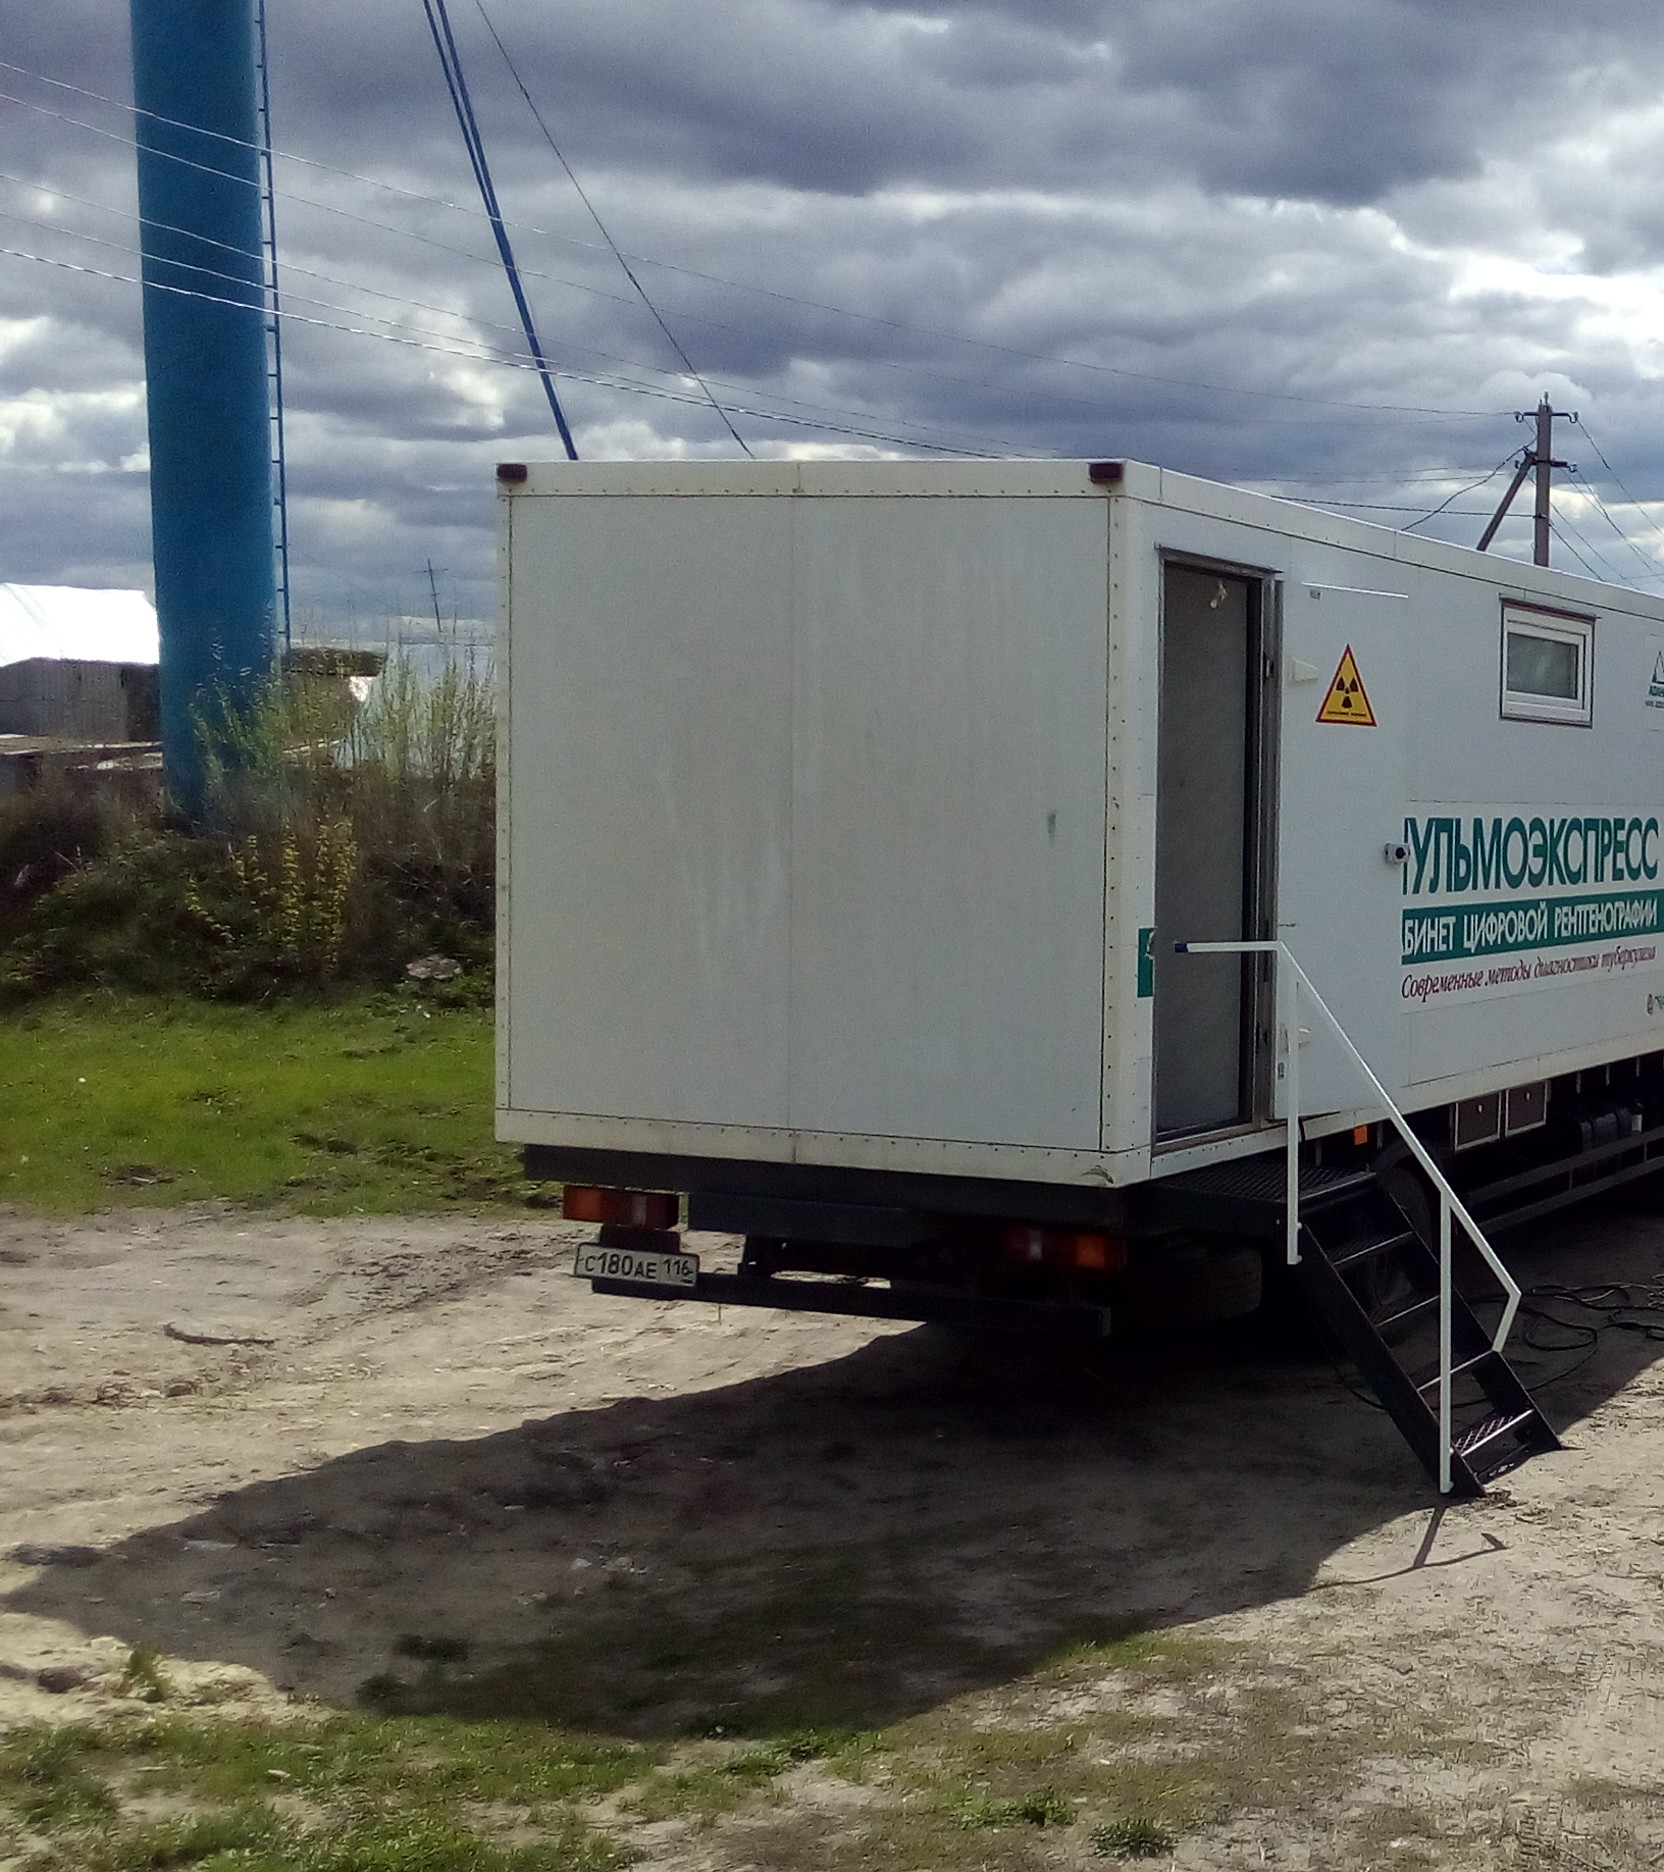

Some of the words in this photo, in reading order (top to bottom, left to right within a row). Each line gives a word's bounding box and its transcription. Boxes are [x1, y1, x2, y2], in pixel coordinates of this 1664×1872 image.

[1403, 817, 1659, 895] УЛЬМОЭКСПРЕСС
[1402, 916, 1457, 957] БИНЕТ
[1463, 902, 1548, 953] ЦИФРОВОЙ
[1554, 898, 1658, 938] РЕНТГЕНОГРАФИИ
[1401, 970, 1484, 1003] Современные
[1486, 959, 1532, 987] методы
